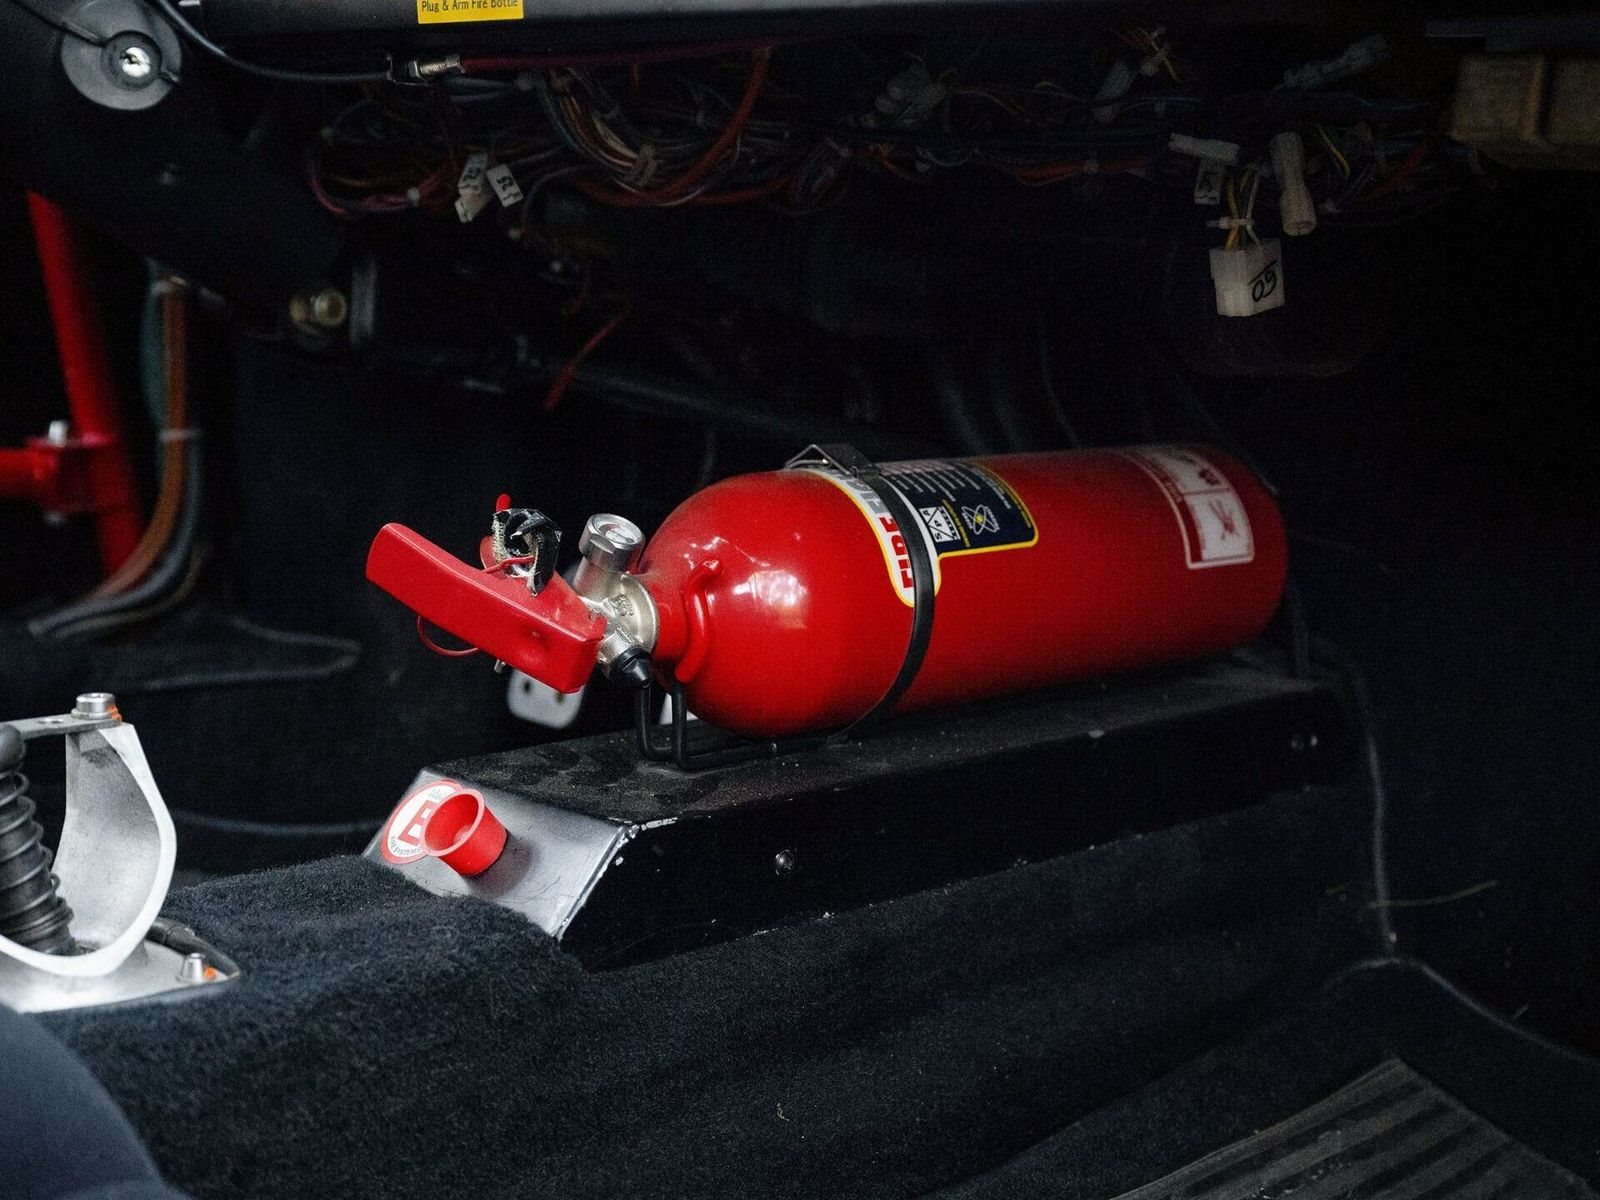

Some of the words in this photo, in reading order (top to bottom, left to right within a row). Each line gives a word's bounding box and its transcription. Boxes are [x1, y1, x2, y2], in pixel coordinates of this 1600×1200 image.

[422, 1, 439, 12] Plug
[442, 0, 449, 11] &
[452, 0, 469, 10] Arm
[472, 0, 488, 9] Fire
